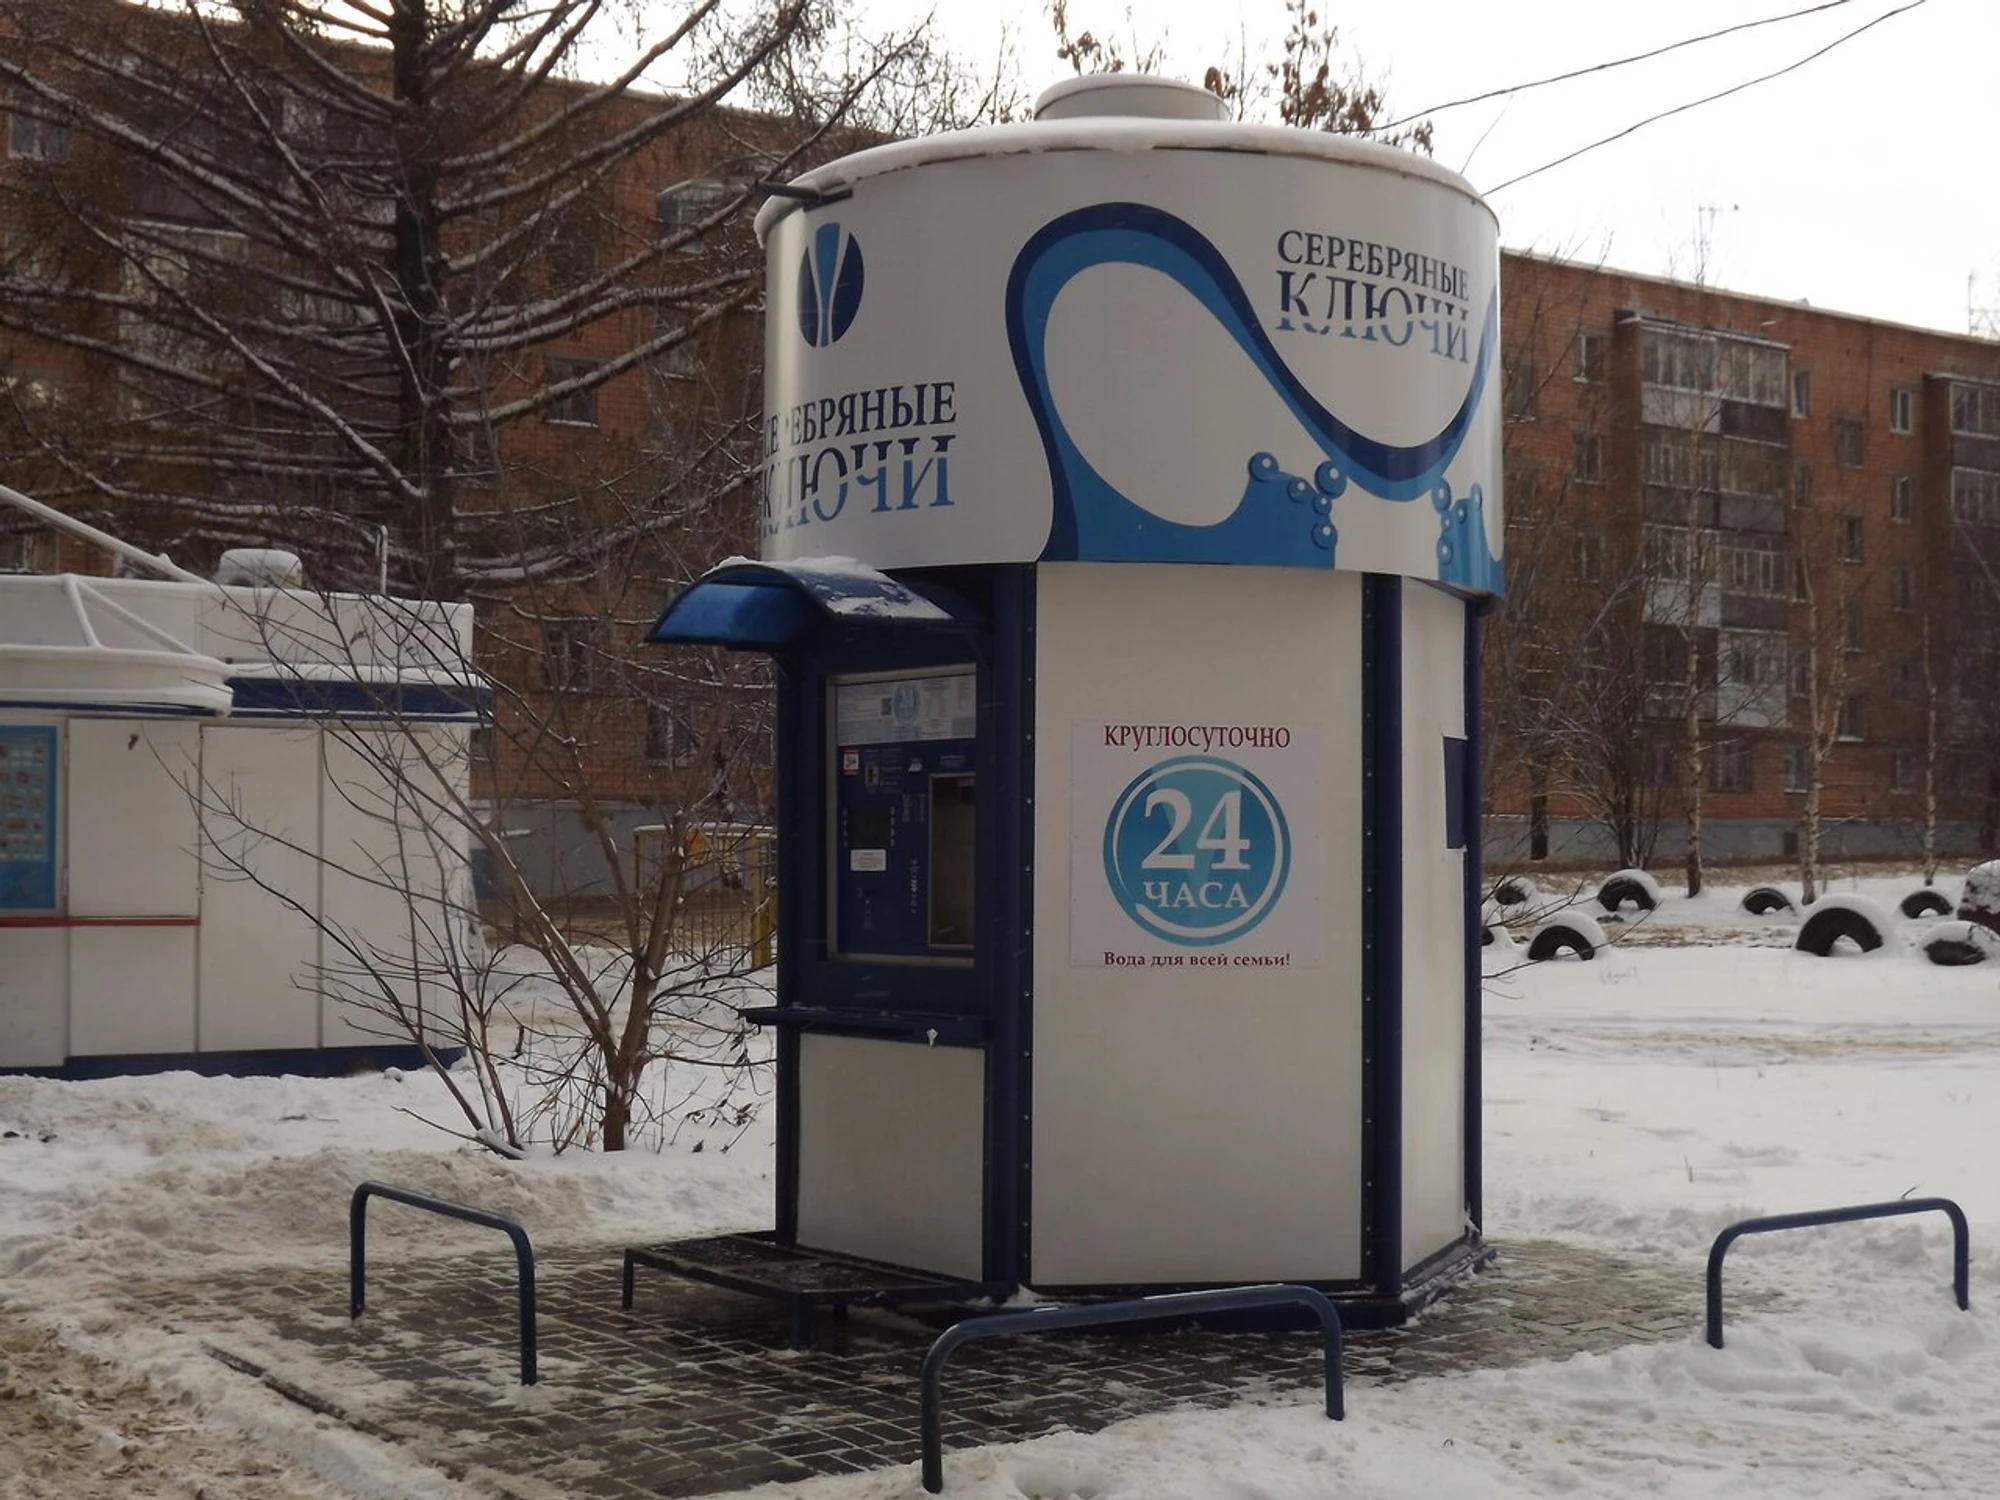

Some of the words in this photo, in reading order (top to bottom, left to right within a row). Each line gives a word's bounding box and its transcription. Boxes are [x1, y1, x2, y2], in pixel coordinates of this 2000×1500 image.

[1277, 229, 1470, 301] СЕРЕБРЯНЫЕ
[1275, 269, 1470, 364] КЛЮЧИ
[763, 381, 957, 459] СЕЕБРЯНЫЕ
[1104, 725, 1291, 752] КРУГЛОСУТОЧНО
[1141, 788, 1250, 869] 24
[1143, 881, 1250, 909] ЧАСА
[1104, 951, 1146, 967] Вода
[1150, 954, 1184, 967] для
[1189, 952, 1228, 967] всей
[1233, 953, 1291, 967] семьи!
